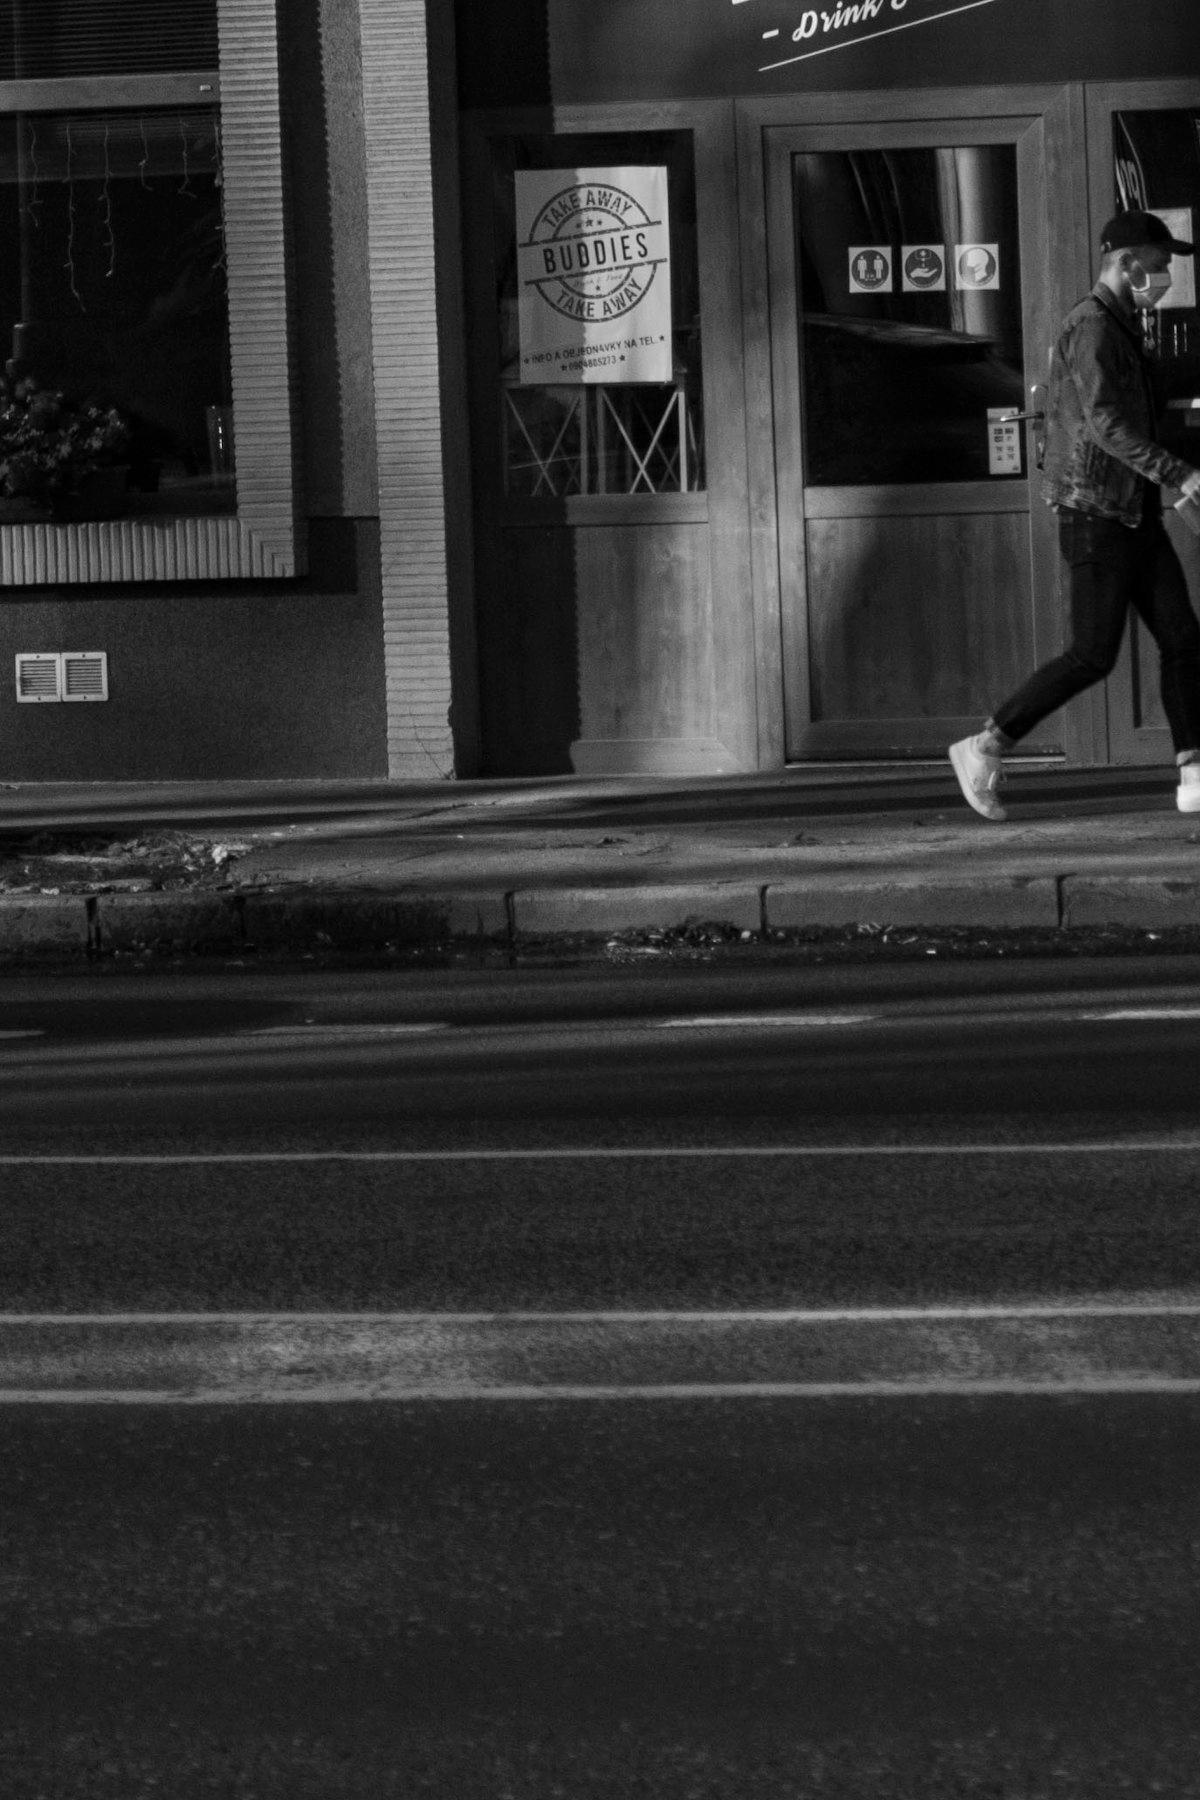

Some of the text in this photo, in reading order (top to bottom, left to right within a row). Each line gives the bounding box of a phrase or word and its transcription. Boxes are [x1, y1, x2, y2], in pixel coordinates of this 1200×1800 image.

[541, 189, 633, 228] TAKE AWAY
[543, 233, 648, 274] BUDDIES
[556, 290, 595, 318] TAKE
[602, 278, 642, 316] AWAY
[624, 338, 638, 349] NA
